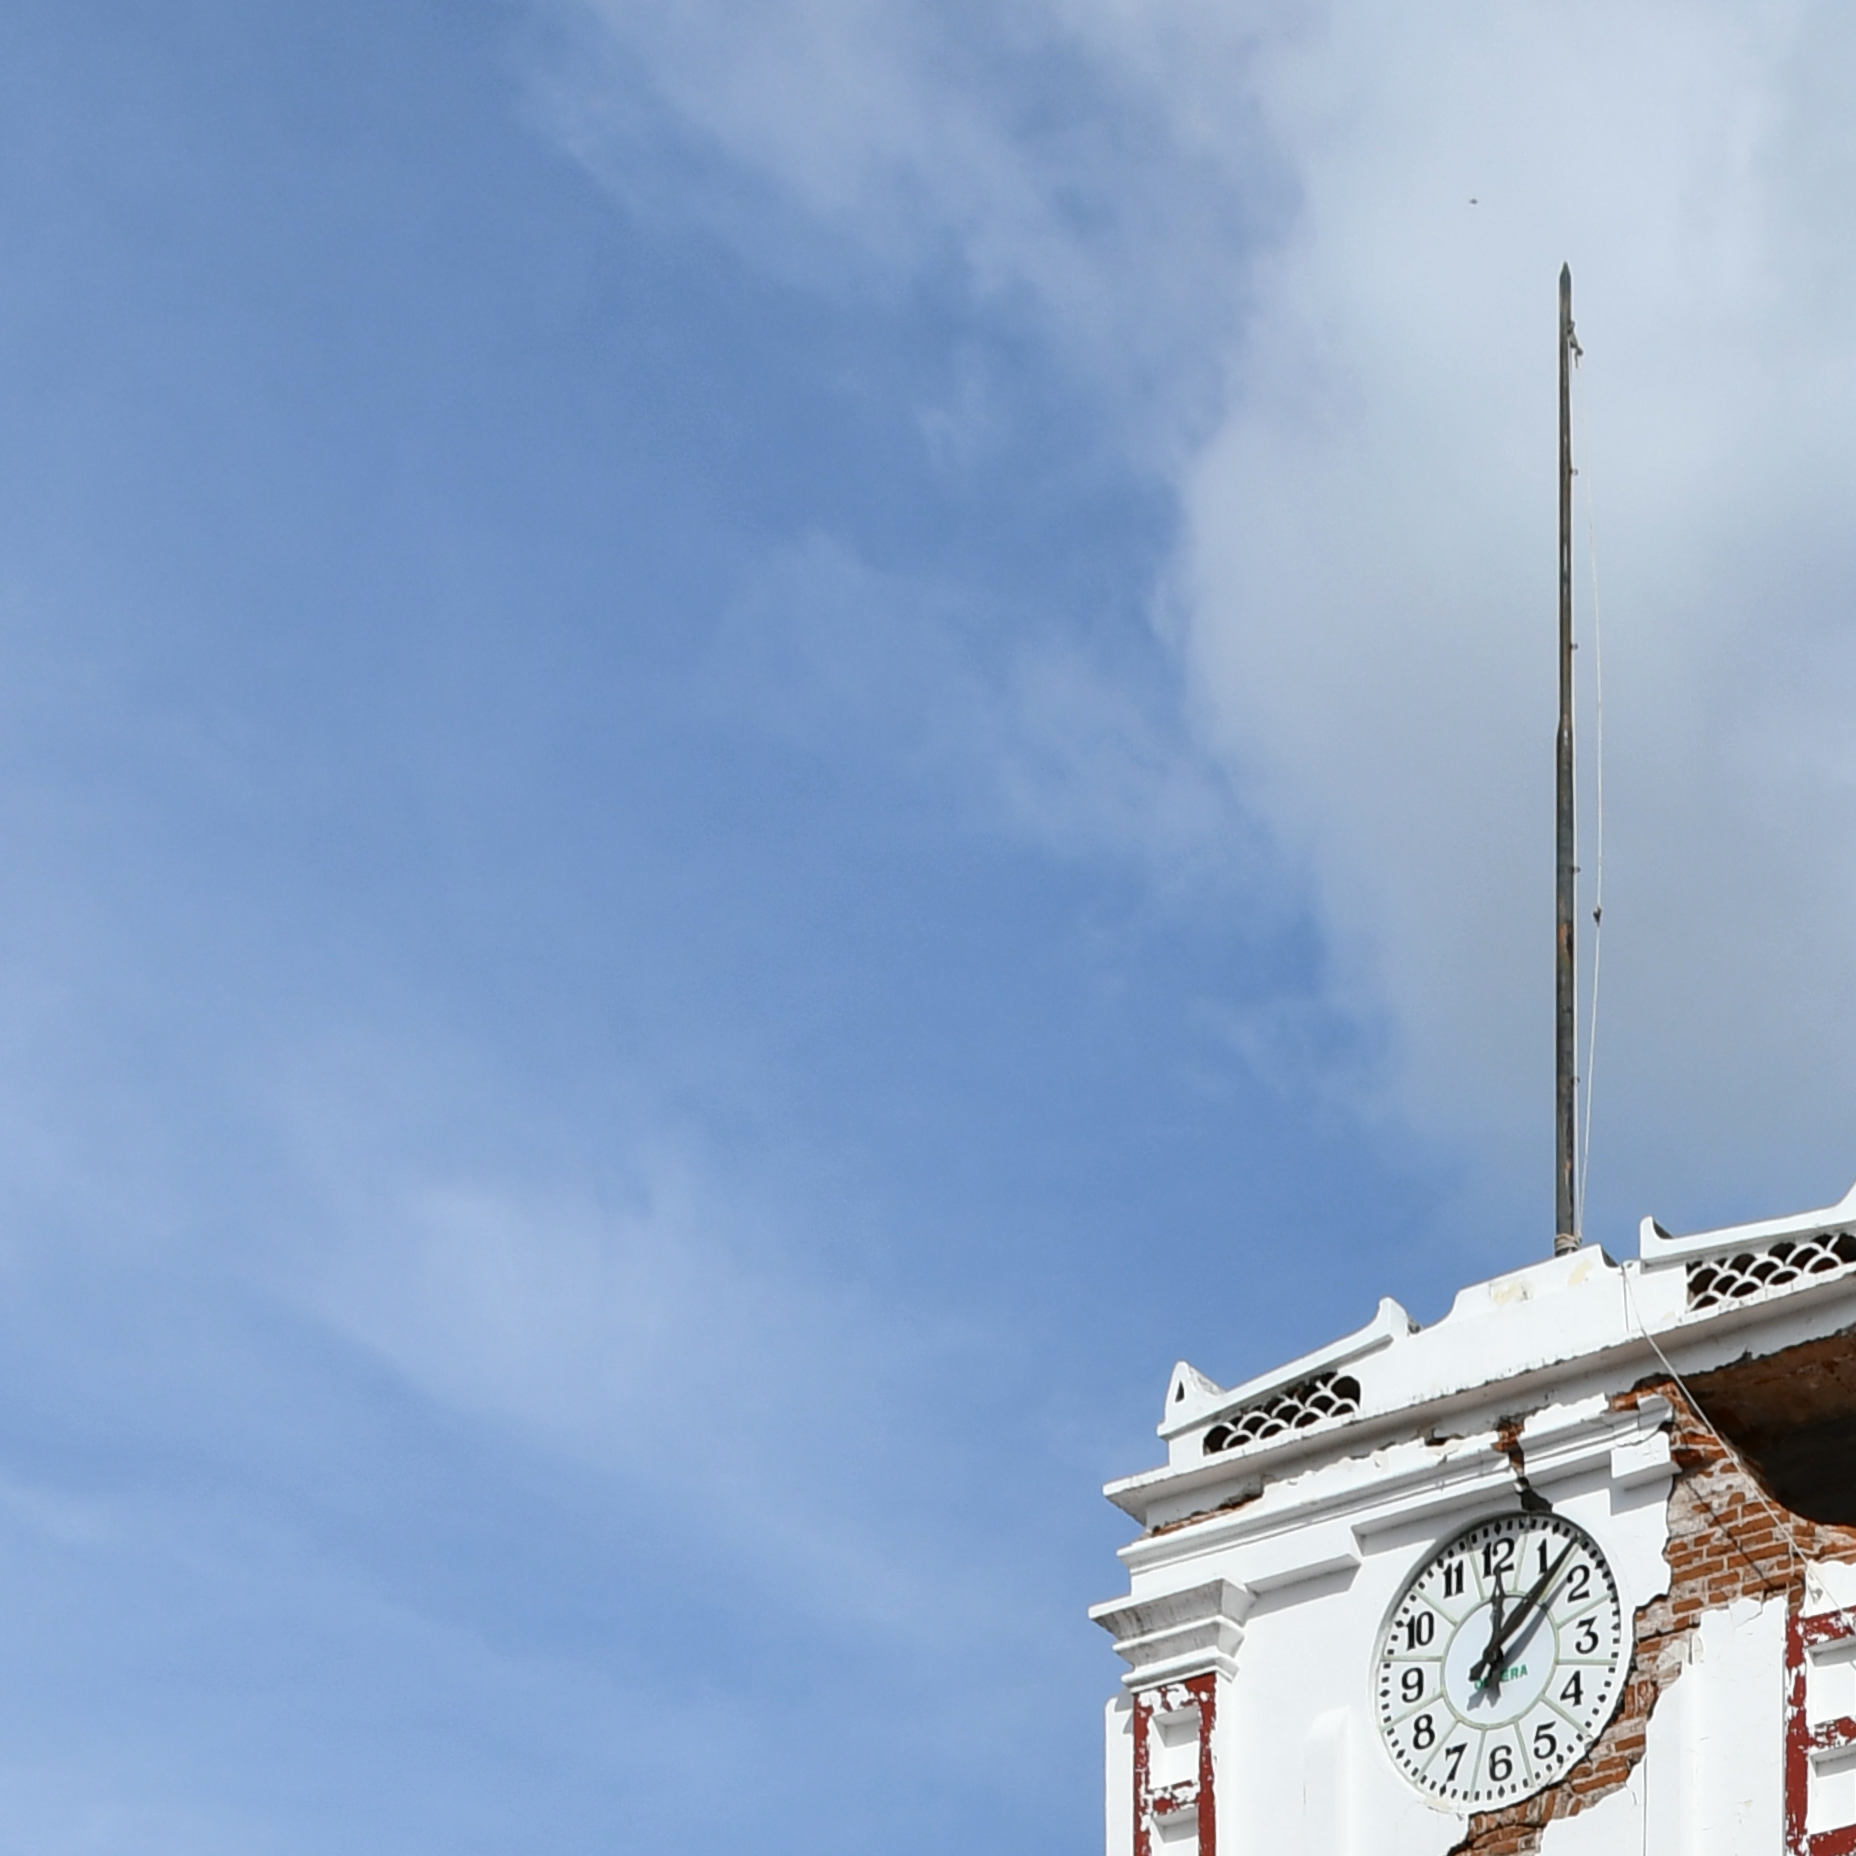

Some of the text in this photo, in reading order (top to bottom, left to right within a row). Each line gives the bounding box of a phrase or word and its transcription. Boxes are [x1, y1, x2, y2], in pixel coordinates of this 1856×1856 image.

[1482, 1537, 1516, 1579] 12
[1537, 1539, 1549, 1575] 1
[1443, 1559, 1465, 1599] 11
[1566, 1564, 1591, 1603] 2
[1406, 1611, 1435, 1651] 10
[1575, 1616, 1599, 1654] 3
[1401, 1668, 1425, 1703] 9
[1474, 1663, 1528, 1692] OERA
[1559, 1670, 1585, 1707] 4
[1413, 1714, 1436, 1749] 8
[1533, 1721, 1557, 1759] 5
[1445, 1742, 1468, 1782] 7
[1489, 1745, 1513, 1782] 6
